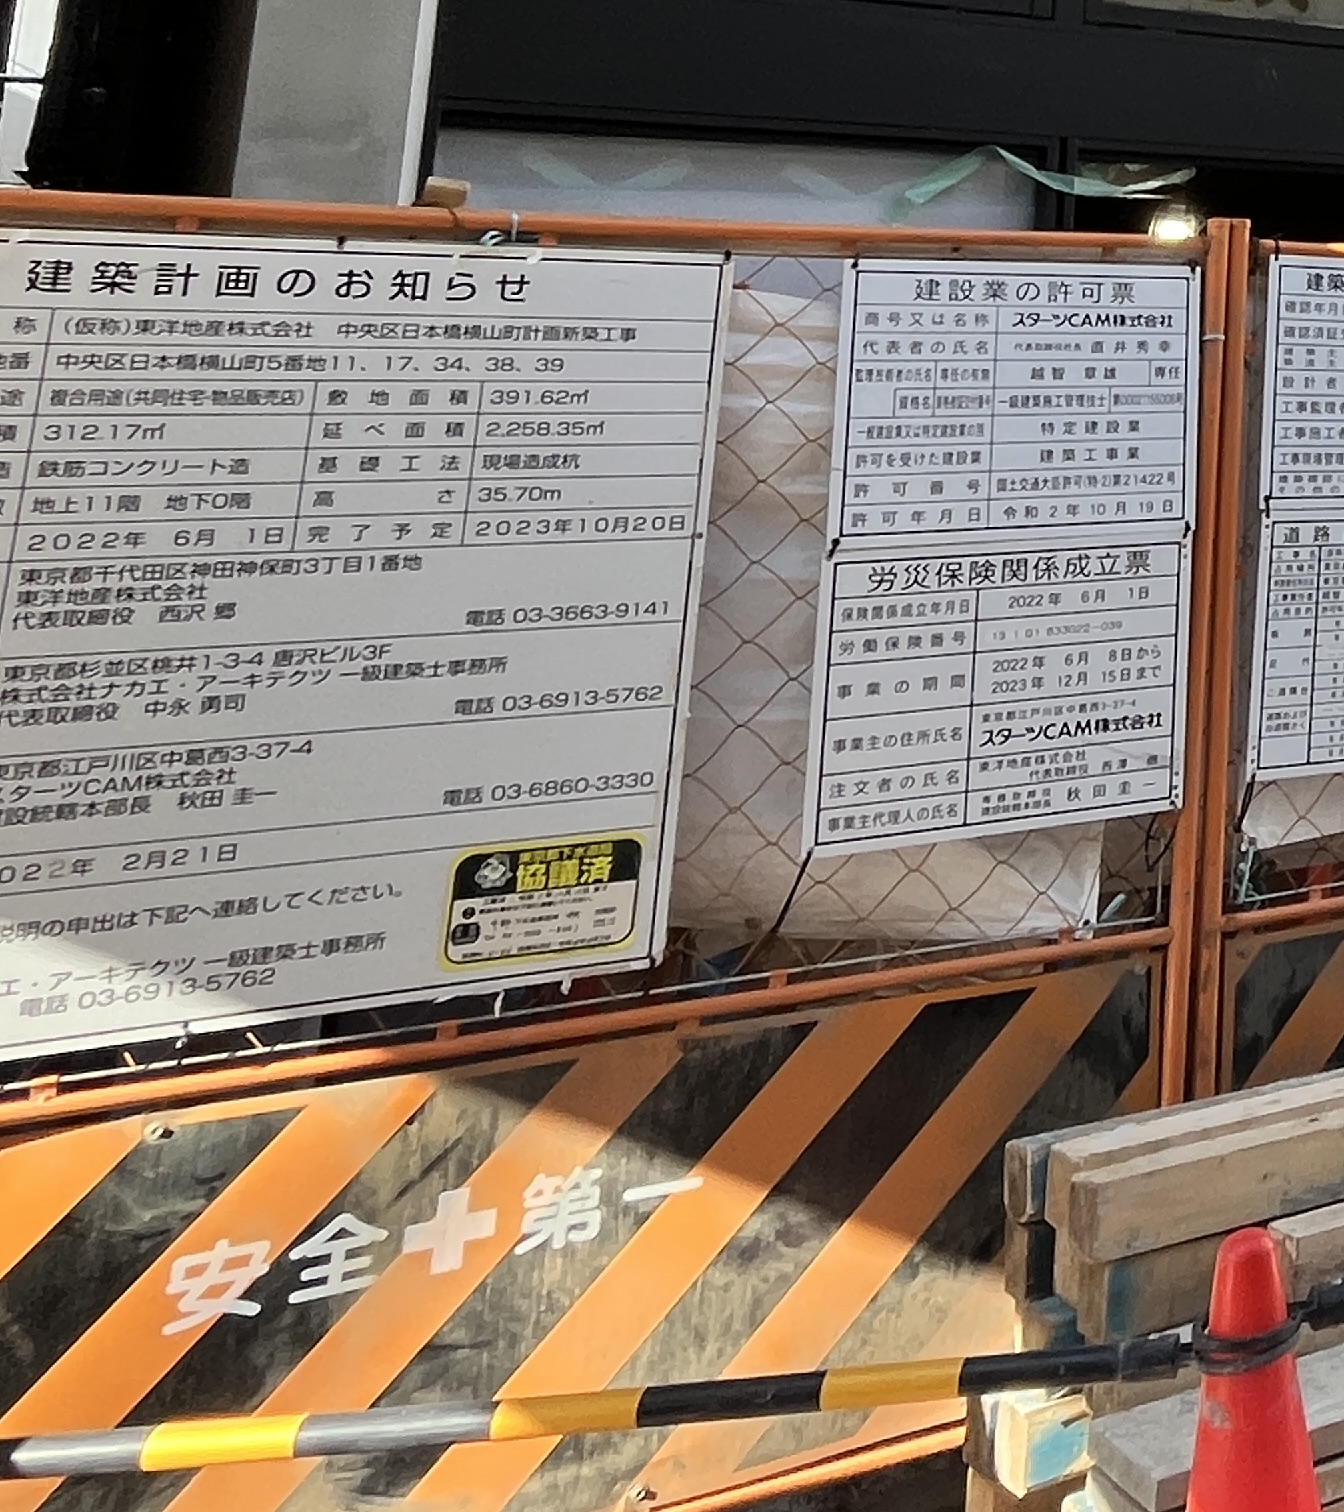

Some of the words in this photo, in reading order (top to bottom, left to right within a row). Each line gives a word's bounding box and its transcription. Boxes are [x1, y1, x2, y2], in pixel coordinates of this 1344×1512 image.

[25, 259, 530, 303] 建築計画のお知らせ
[913, 278, 1136, 304] 建設業の許可票
[64, 317, 313, 339] (仮称)東洋地産株式会社
[337, 322, 638, 344] 中央区日本橋横山町計画新築工事
[864, 310, 990, 328] 商号又は名称
[1012, 311, 1173, 329] スターツCAM株式会社
[861, 340, 989, 355] 代表者の氏名
[1154, 366, 1181, 379] 専任
[326, 389, 469, 407] 敷地面積
[322, 421, 467, 439] 延べ面積
[1040, 420, 1140, 435] 特定建設業
[318, 454, 461, 474] 基礎工法
[481, 454, 580, 472] 現場造成杭
[855, 450, 982, 469] 許可を受けた建設業
[1039, 446, 1140, 463] 建築工事業
[37, 457, 250, 479] 鉄筋コンクリート造
[312, 489, 456, 509] 高さ
[478, 486, 562, 504] 35.70m
[853, 479, 981, 498] 許可番号
[31, 494, 142, 514] 地上11階
[163, 492, 252, 512] 地下0階
[475, 514, 686, 538] 2023年10月20日
[851, 507, 982, 528] 許可年月日
[27, 531, 147, 552] 2022年
[173, 529, 216, 548] 6月
[247, 527, 285, 545] 1日
[307, 521, 454, 545] 完了予定
[20, 554, 424, 586] 東京都千代田区神田神保町3丁目1番地
[866, 549, 1152, 593] 労災保険関係成立票
[16, 582, 209, 608] 東洋地産株式会社
[1007, 592, 1062, 610] 2022年
[1080, 589, 1106, 604] 6月
[1128, 585, 1150, 600] 1日
[12, 606, 136, 631] 代表取締役
[465, 609, 505, 628] 電話
[512, 600, 670, 625] 03-3663-9141
[840, 598, 970, 623] 保険関係成立年月日
[838, 630, 967, 656] 労働保険番号
[5, 650, 264, 682] 東京都杉並区桃井1-3-4
[272, 642, 393, 669] 唐沢ビル3F
[339, 655, 509, 683] 一級建築士事務所
[992, 655, 1046, 673] 2022年
[1064, 651, 1090, 667] 6月
[836, 673, 966, 700] 事業の期間
[991, 675, 1045, 694] 2023年
[1056, 670, 1088, 687] 12月
[1101, 664, 1161, 683] 15日まで
[454, 697, 495, 716] 電話
[502, 684, 664, 713] 03-6913-5762
[0, 702, 120, 728] 代表取締役
[831, 725, 963, 755] 事業主の住所氏名
[978, 711, 1163, 748] スターツCAM株式会社
[0, 767, 237, 804] ターツCAM株式会社
[443, 787, 483, 807] 電話
[491, 771, 654, 803] 03-6860-3330
[828, 768, 960, 799] 注文者の氏名
[0, 794, 153, 827] 設統轄本部長
[827, 801, 959, 833] 事業主代理人の氏名
[121, 842, 239, 872] 2月21日
[516, 855, 613, 894] 協議済
[202, 930, 387, 967] 一級建築士事務所
[19, 992, 69, 1017] 電話
[78, 966, 276, 1010] 03-6913-5762
[162, 1211, 389, 1336] 安全
[514, 1165, 705, 1256] 第一
